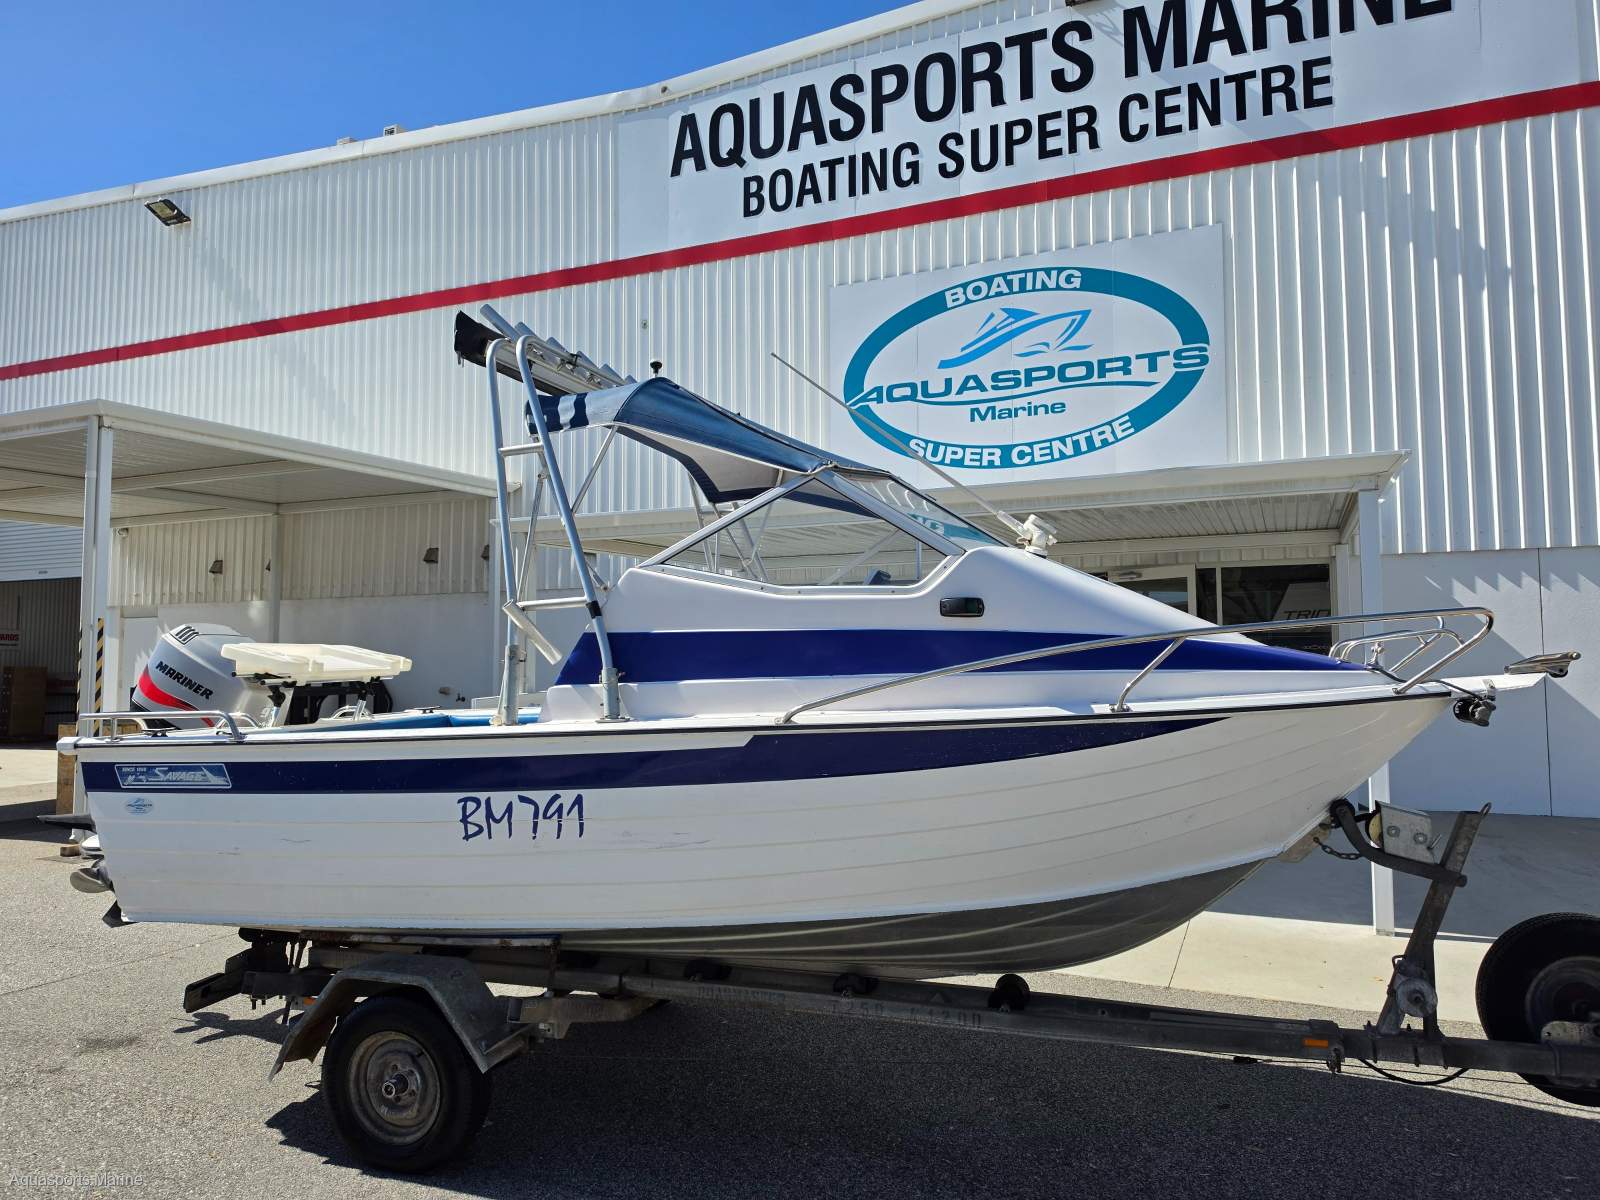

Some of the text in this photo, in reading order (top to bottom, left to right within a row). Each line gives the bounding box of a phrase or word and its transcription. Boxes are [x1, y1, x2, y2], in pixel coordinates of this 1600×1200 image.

[669, 0, 1452, 178] AQUASPORTS MARI
[742, 57, 1332, 218] BOATING SUPER CENTRE
[944, 269, 1082, 309] BOATING
[846, 343, 1210, 408] AQUASPORTS
[969, 401, 1066, 423] Marine
[908, 414, 1135, 467] SUPER CENTRE
[155, 660, 214, 700] MARINER
